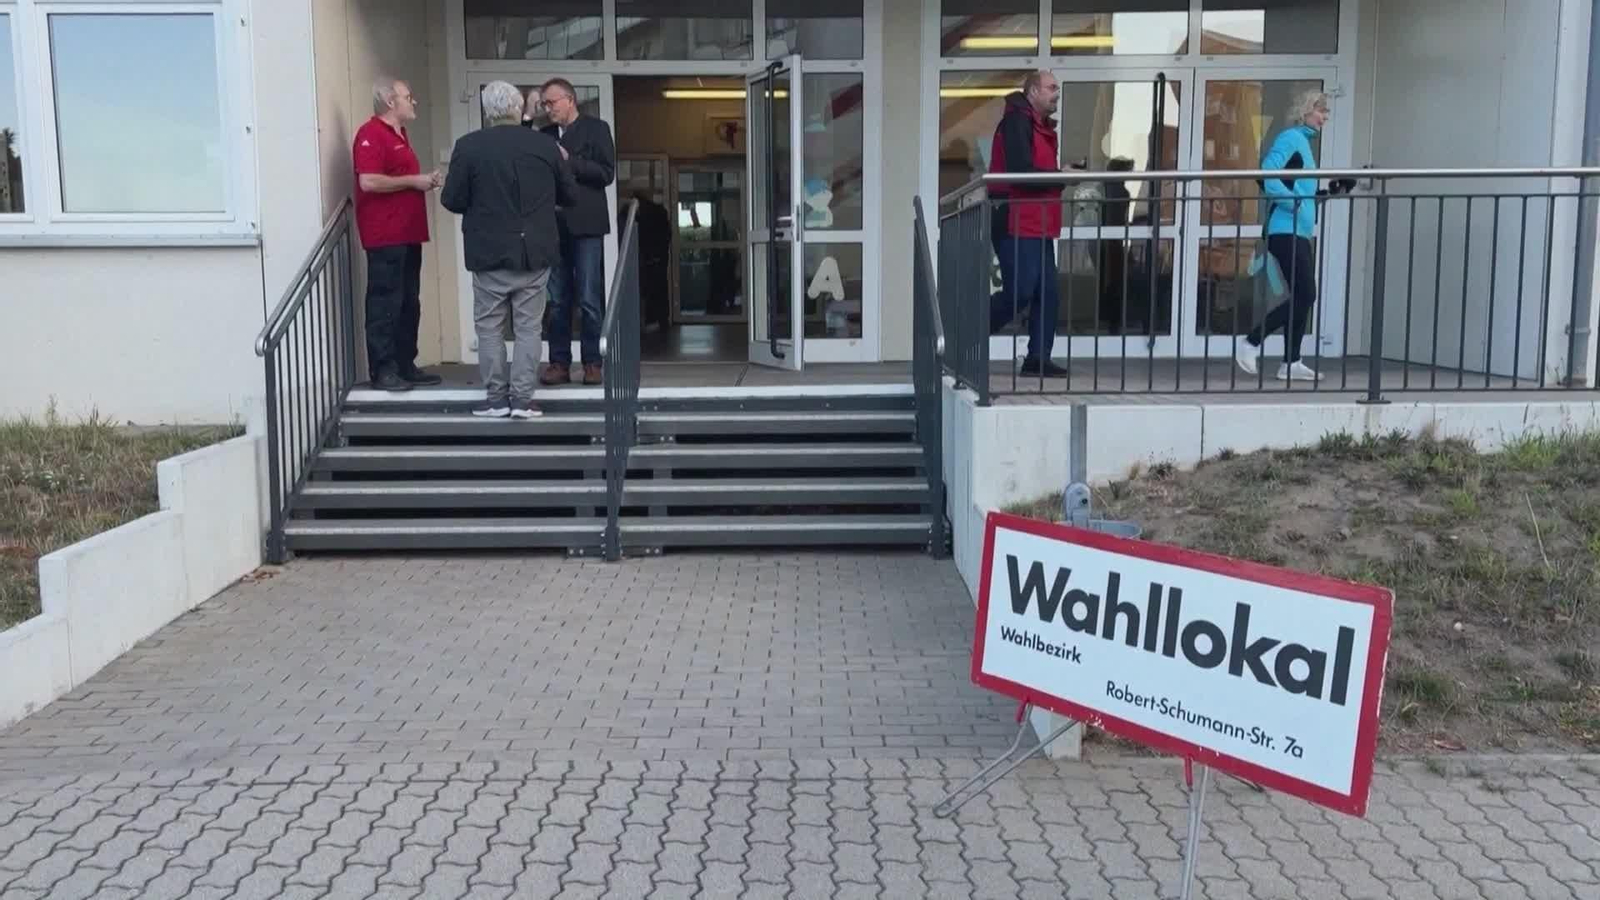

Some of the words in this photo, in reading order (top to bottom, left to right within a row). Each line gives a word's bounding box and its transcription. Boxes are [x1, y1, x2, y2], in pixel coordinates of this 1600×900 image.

[808, 256, 845, 301] A
[1001, 626, 1081, 664] Wahlbezirk
[1007, 554, 1355, 706] Wahllokal
[1106, 680, 1275, 749] Robert-Schumann-Str.
[1285, 736, 1304, 758] 7a
